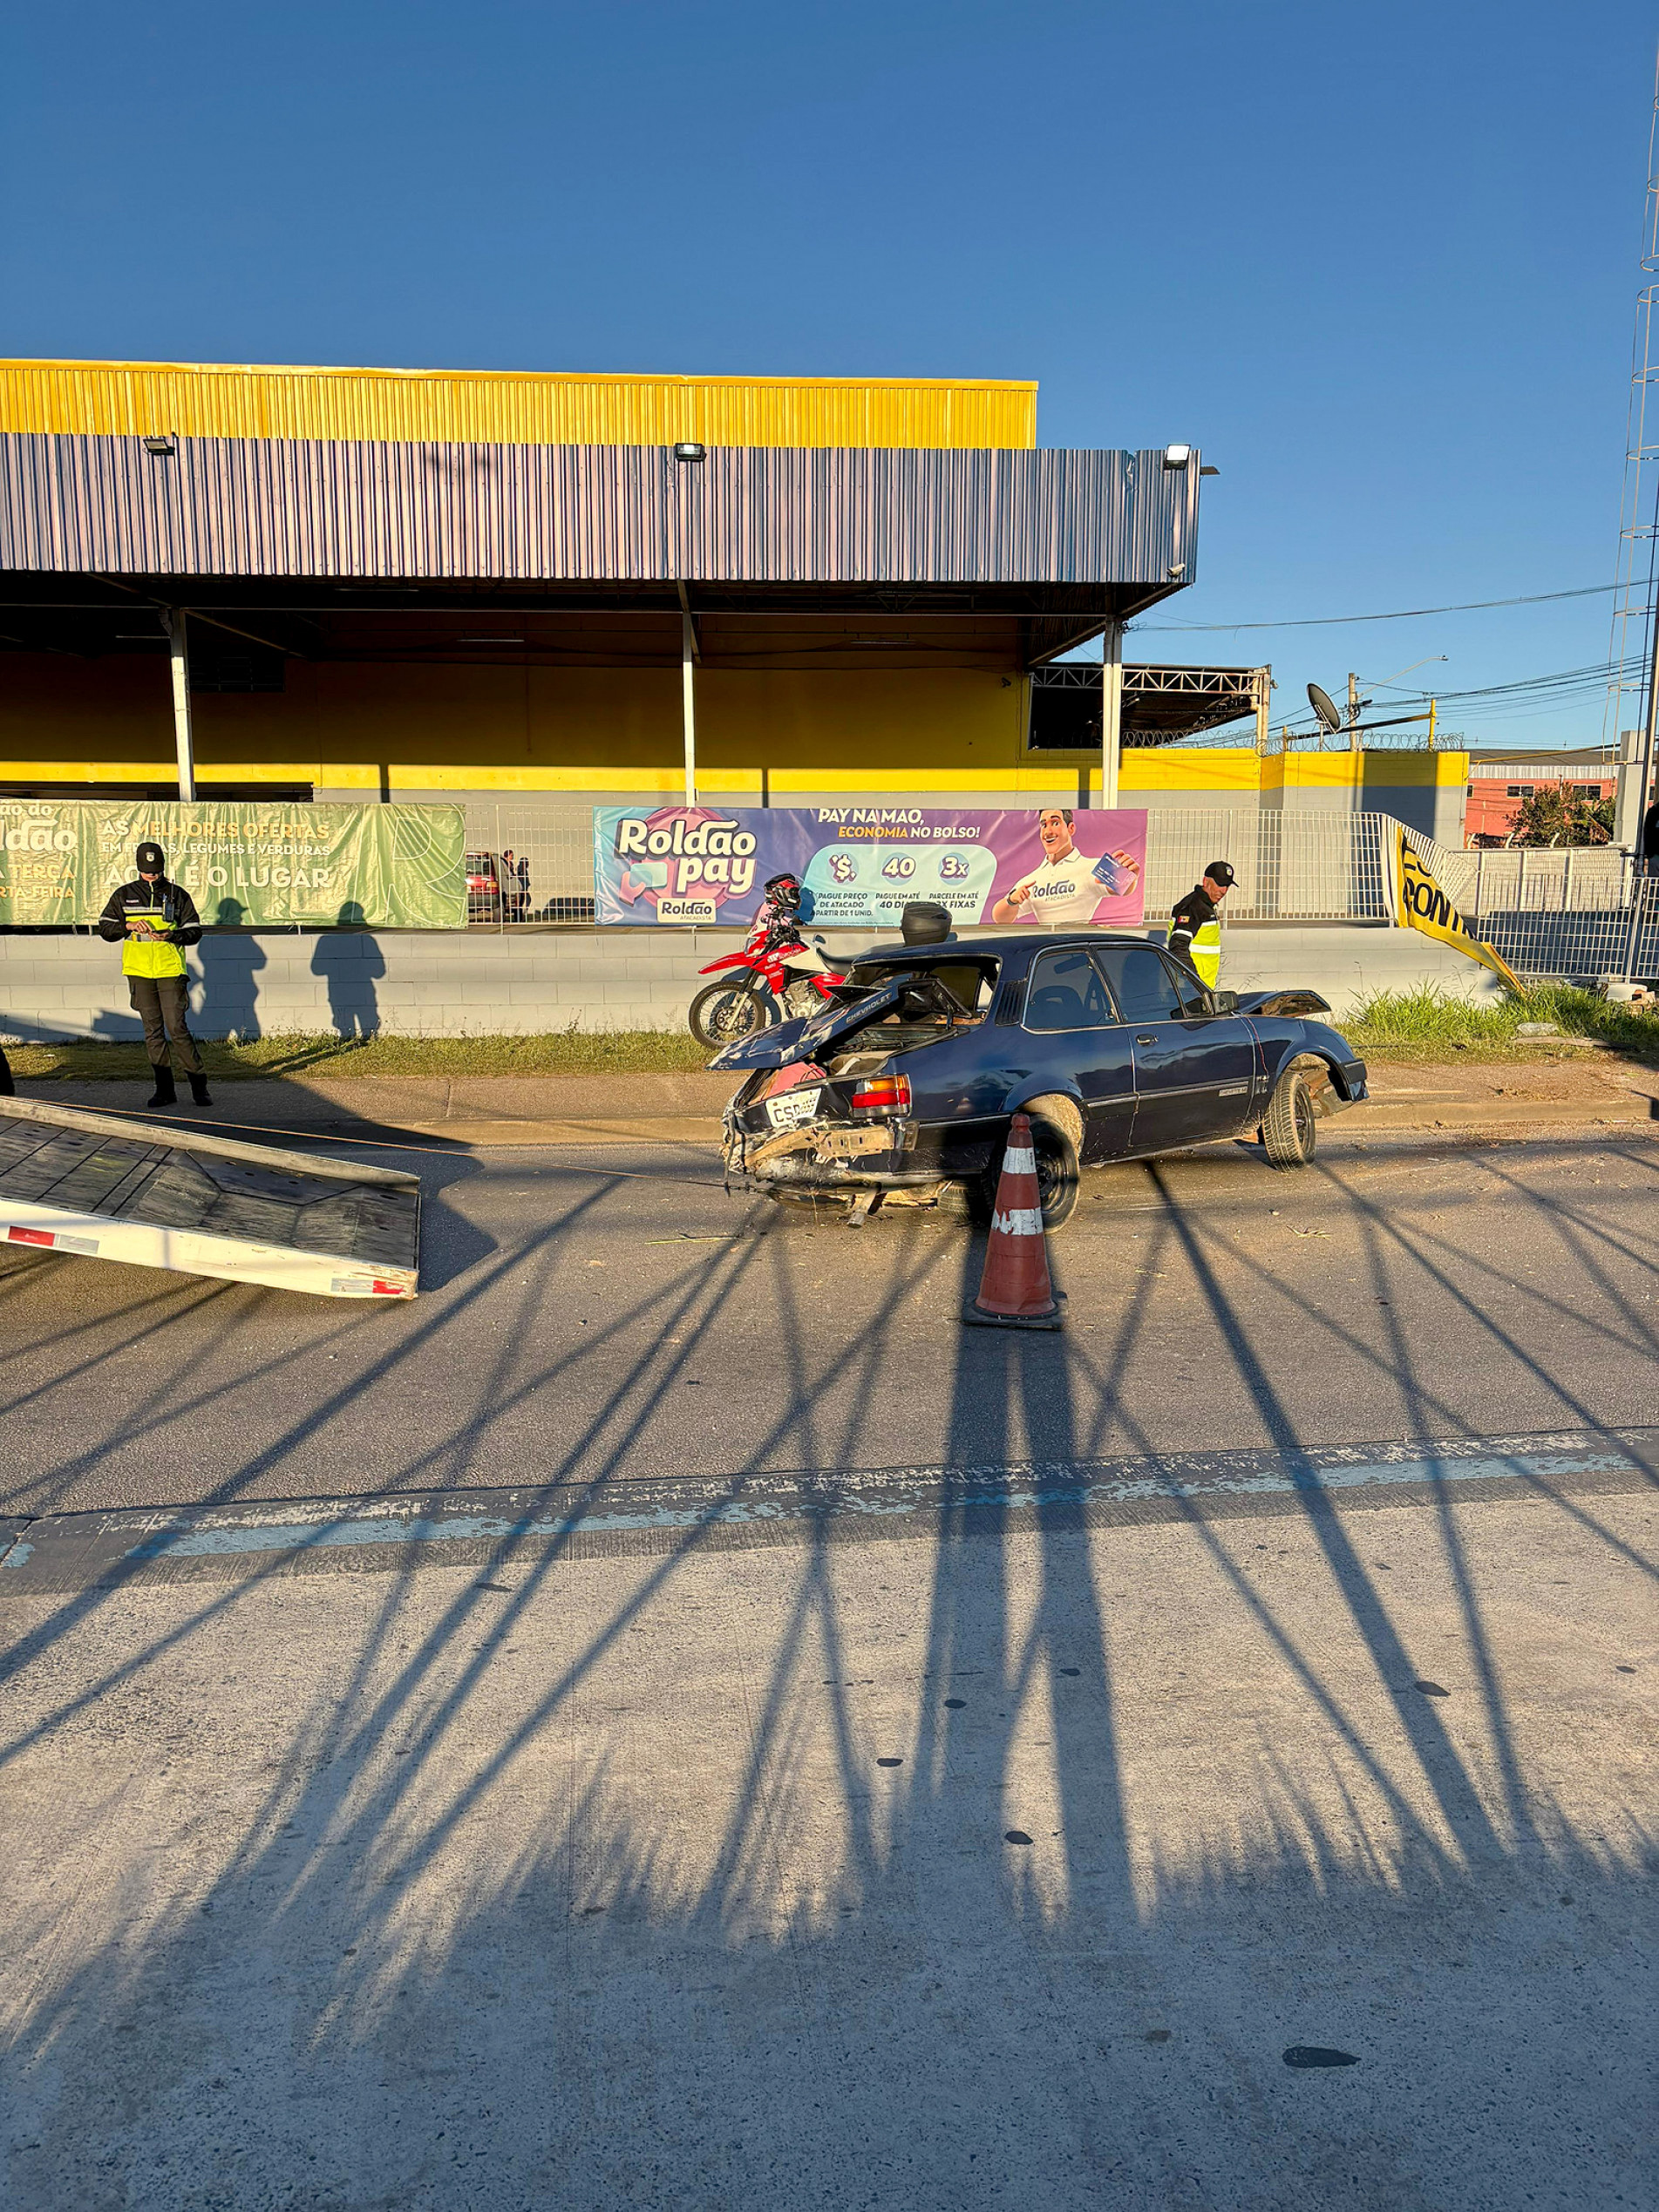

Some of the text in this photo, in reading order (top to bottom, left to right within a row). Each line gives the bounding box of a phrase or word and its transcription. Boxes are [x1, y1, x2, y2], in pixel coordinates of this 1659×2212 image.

[818, 809, 850, 823] PAY
[853, 809, 877, 823] NA
[103, 819, 330, 839] AS MELHORES OFERTAS
[839, 826, 981, 838] ECONOMIA NO BOLSO!
[101, 843, 121, 853] EM
[183, 843, 245, 855] LEGUMES
[247, 844, 255, 855] E
[257, 845, 330, 856] VERDURAS
[8, 864, 76, 882] TERÇA
[186, 859, 200, 887] É
[207, 866, 228, 887] O
[236, 866, 330, 888] LUGAR
[676, 858, 756, 893] pay
[882, 858, 915, 877] 40
[942, 857, 969, 877] 3x
[843, 892, 868, 901] PREÇO
[846, 992, 892, 1024] CHEVROLET
